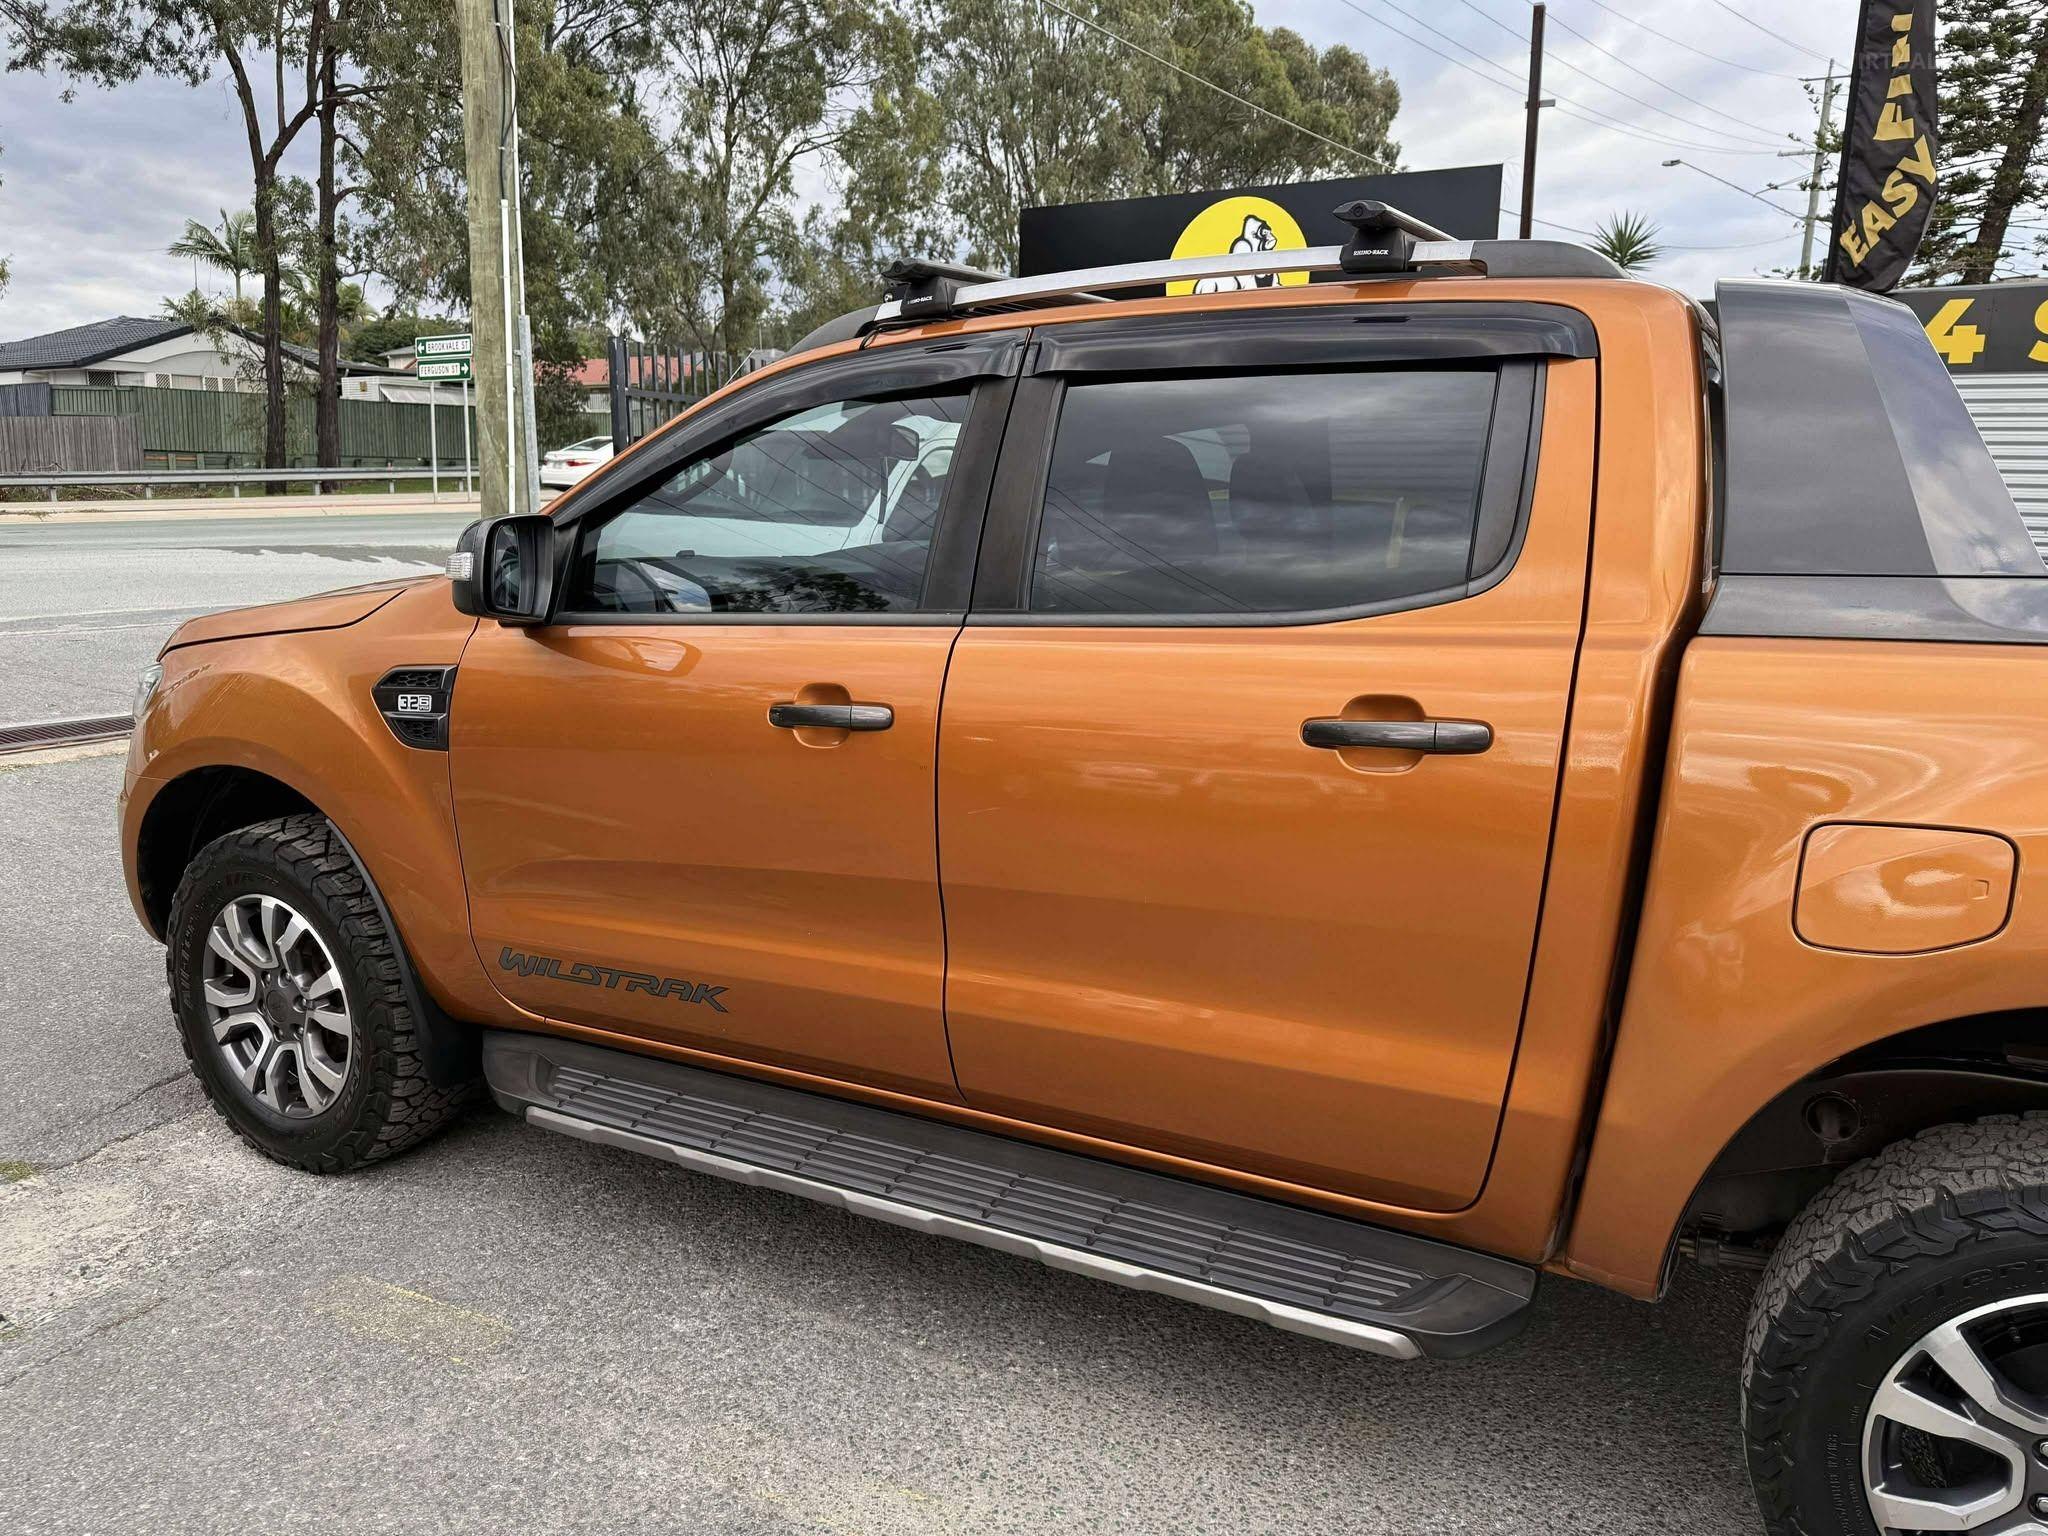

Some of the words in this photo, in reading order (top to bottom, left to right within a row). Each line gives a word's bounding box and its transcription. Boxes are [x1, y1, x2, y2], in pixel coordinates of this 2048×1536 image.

[1839, 134, 1937, 268] EASY
[427, 341, 459, 352] BROOKVALE
[462, 340, 469, 351] ST
[420, 365, 449, 375] FERGUSON
[451, 365, 458, 374] ST
[498, 947, 730, 1013] WILDTRAK
